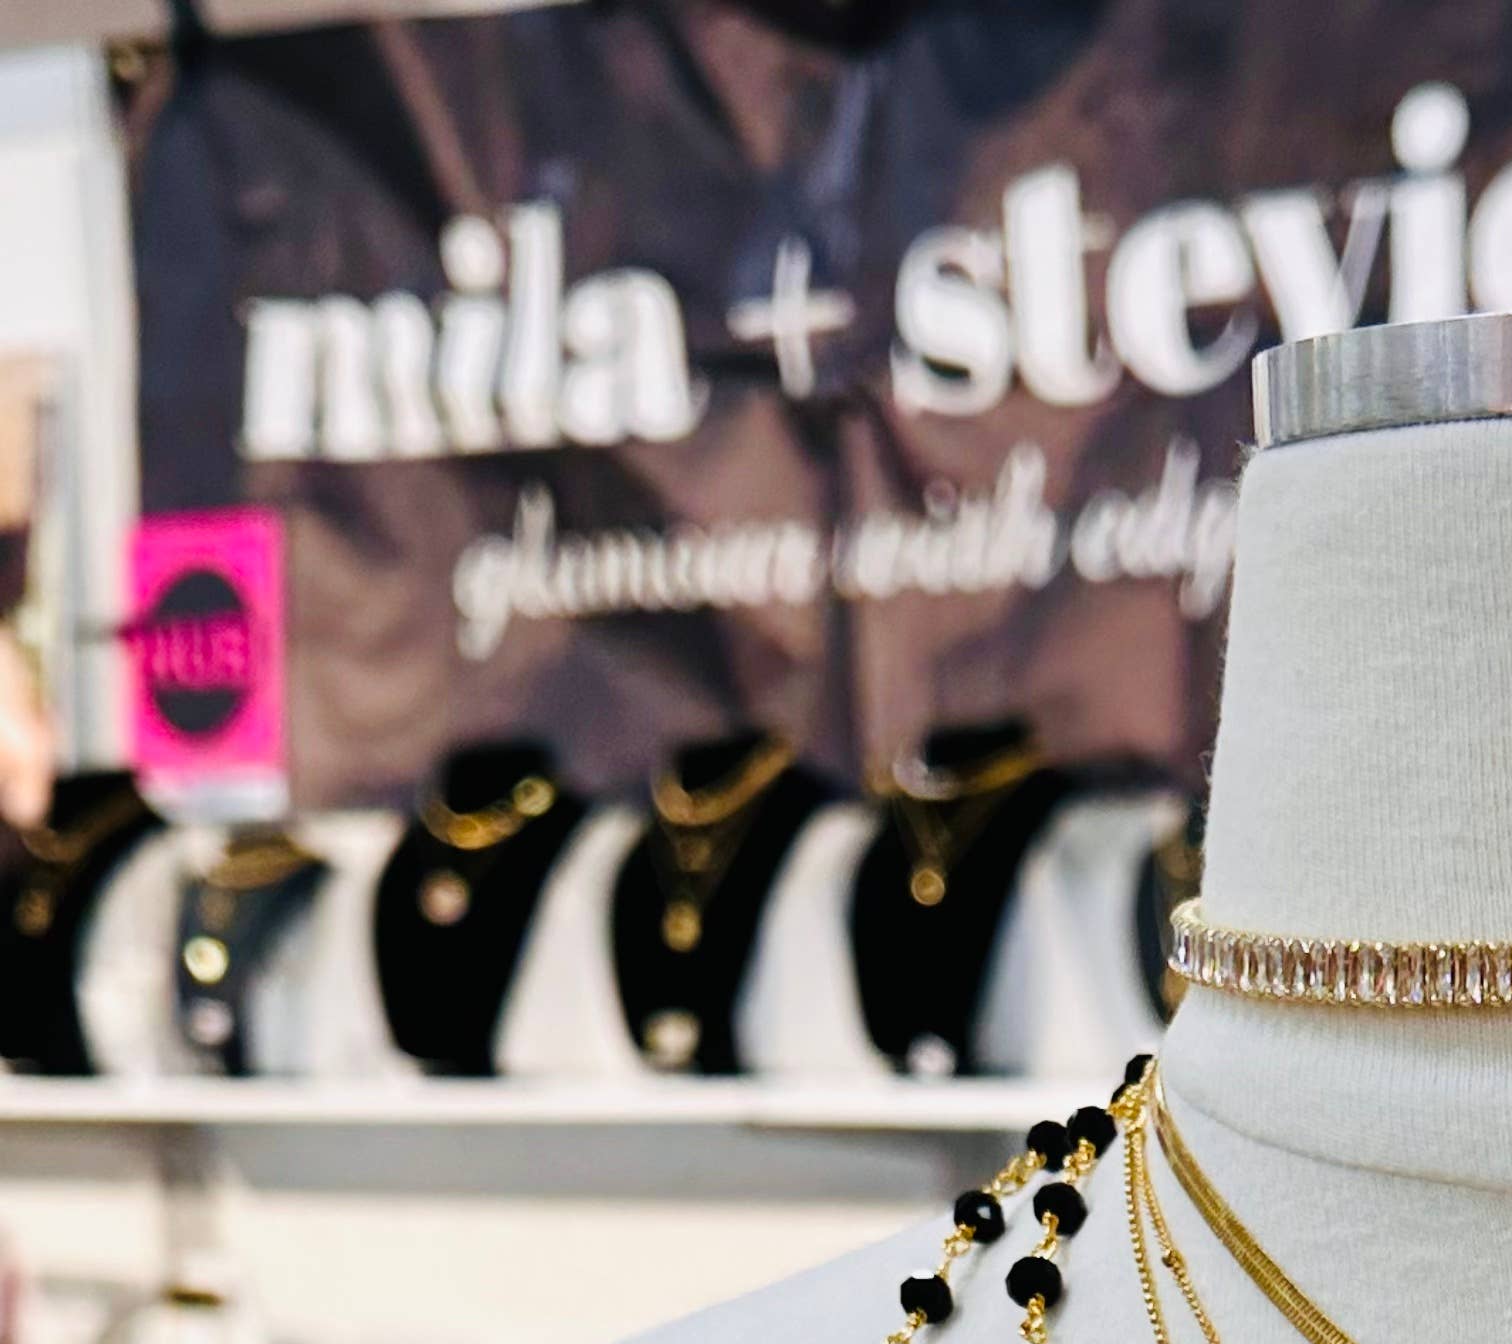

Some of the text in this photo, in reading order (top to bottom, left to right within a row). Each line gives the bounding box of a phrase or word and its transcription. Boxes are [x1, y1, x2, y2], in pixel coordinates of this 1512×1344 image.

[239, 199, 708, 462] mila
[726, 235, 855, 398] +
[453, 435, 1238, 661] glamour with edg
